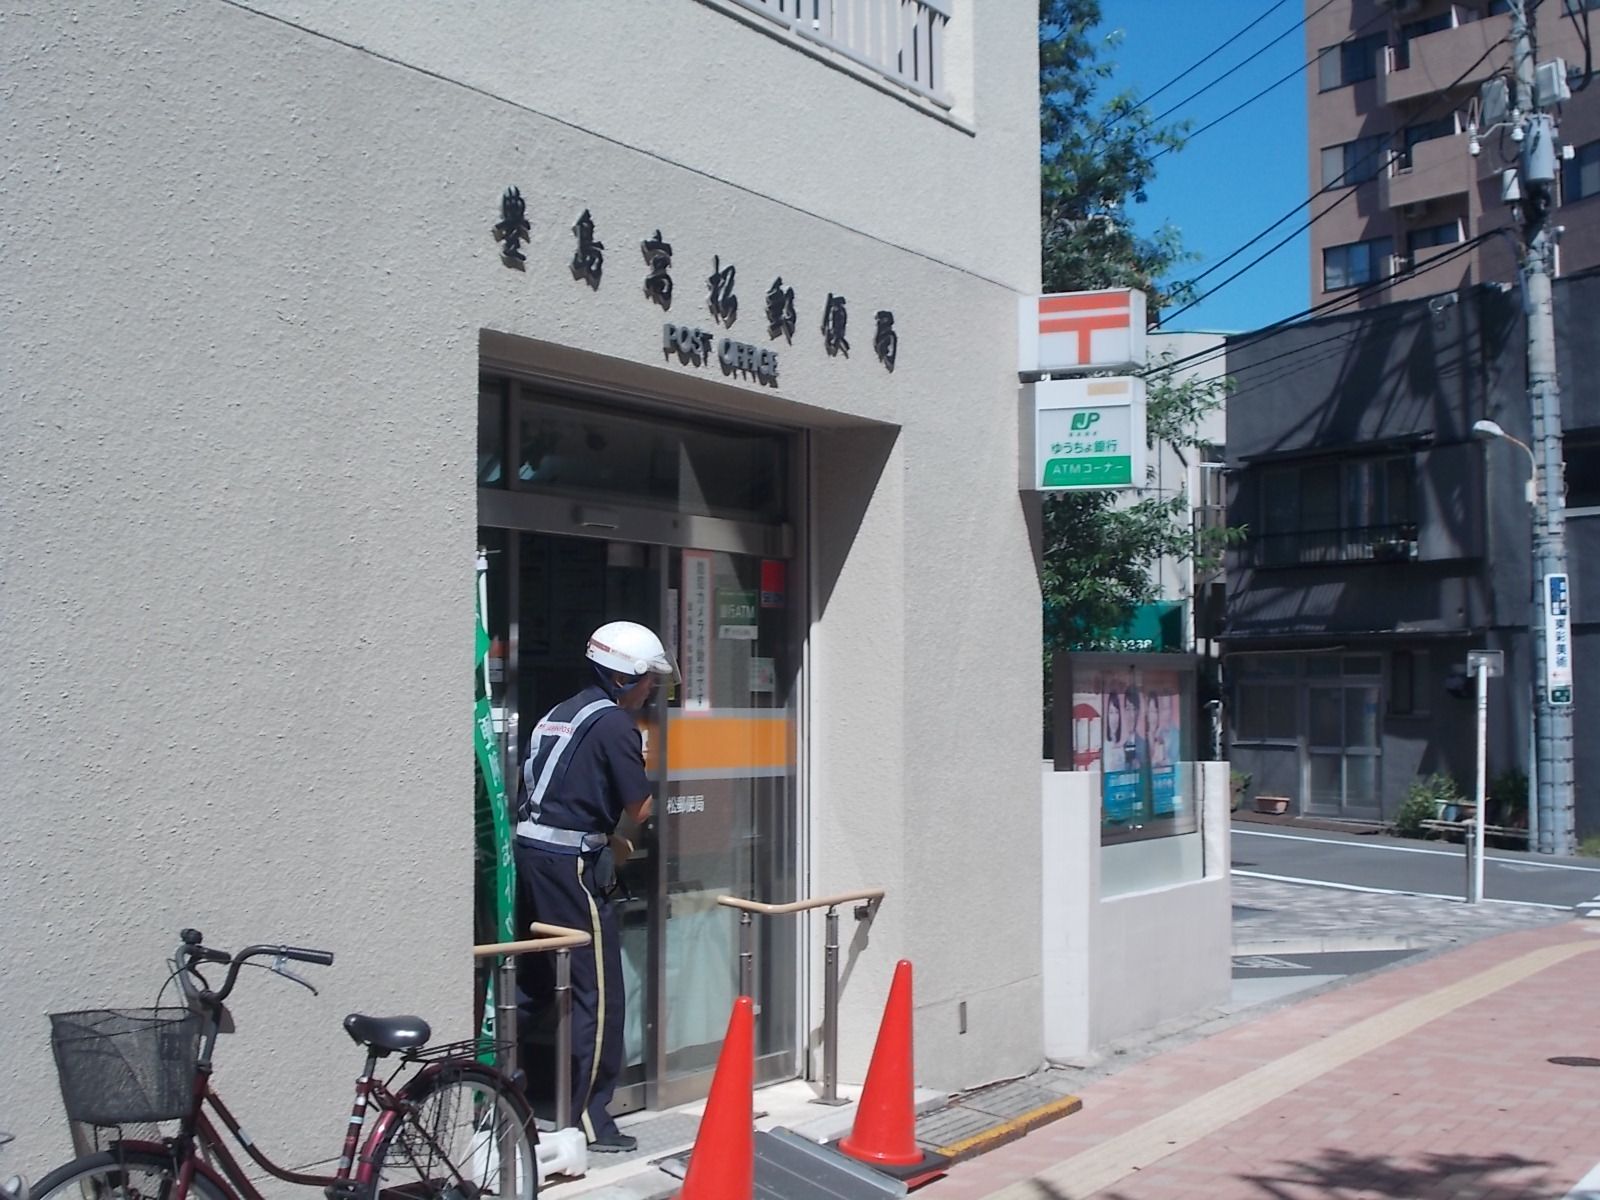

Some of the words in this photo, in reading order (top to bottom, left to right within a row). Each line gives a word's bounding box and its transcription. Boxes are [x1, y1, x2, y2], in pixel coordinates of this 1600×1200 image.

[663, 323, 713, 360] POST
[718, 338, 779, 380] OFFICE
[1070, 412, 1100, 430] JP
[1050, 440, 1118, 454] ゆうちょ銀行
[1052, 462, 1125, 475] ATMコーナー
